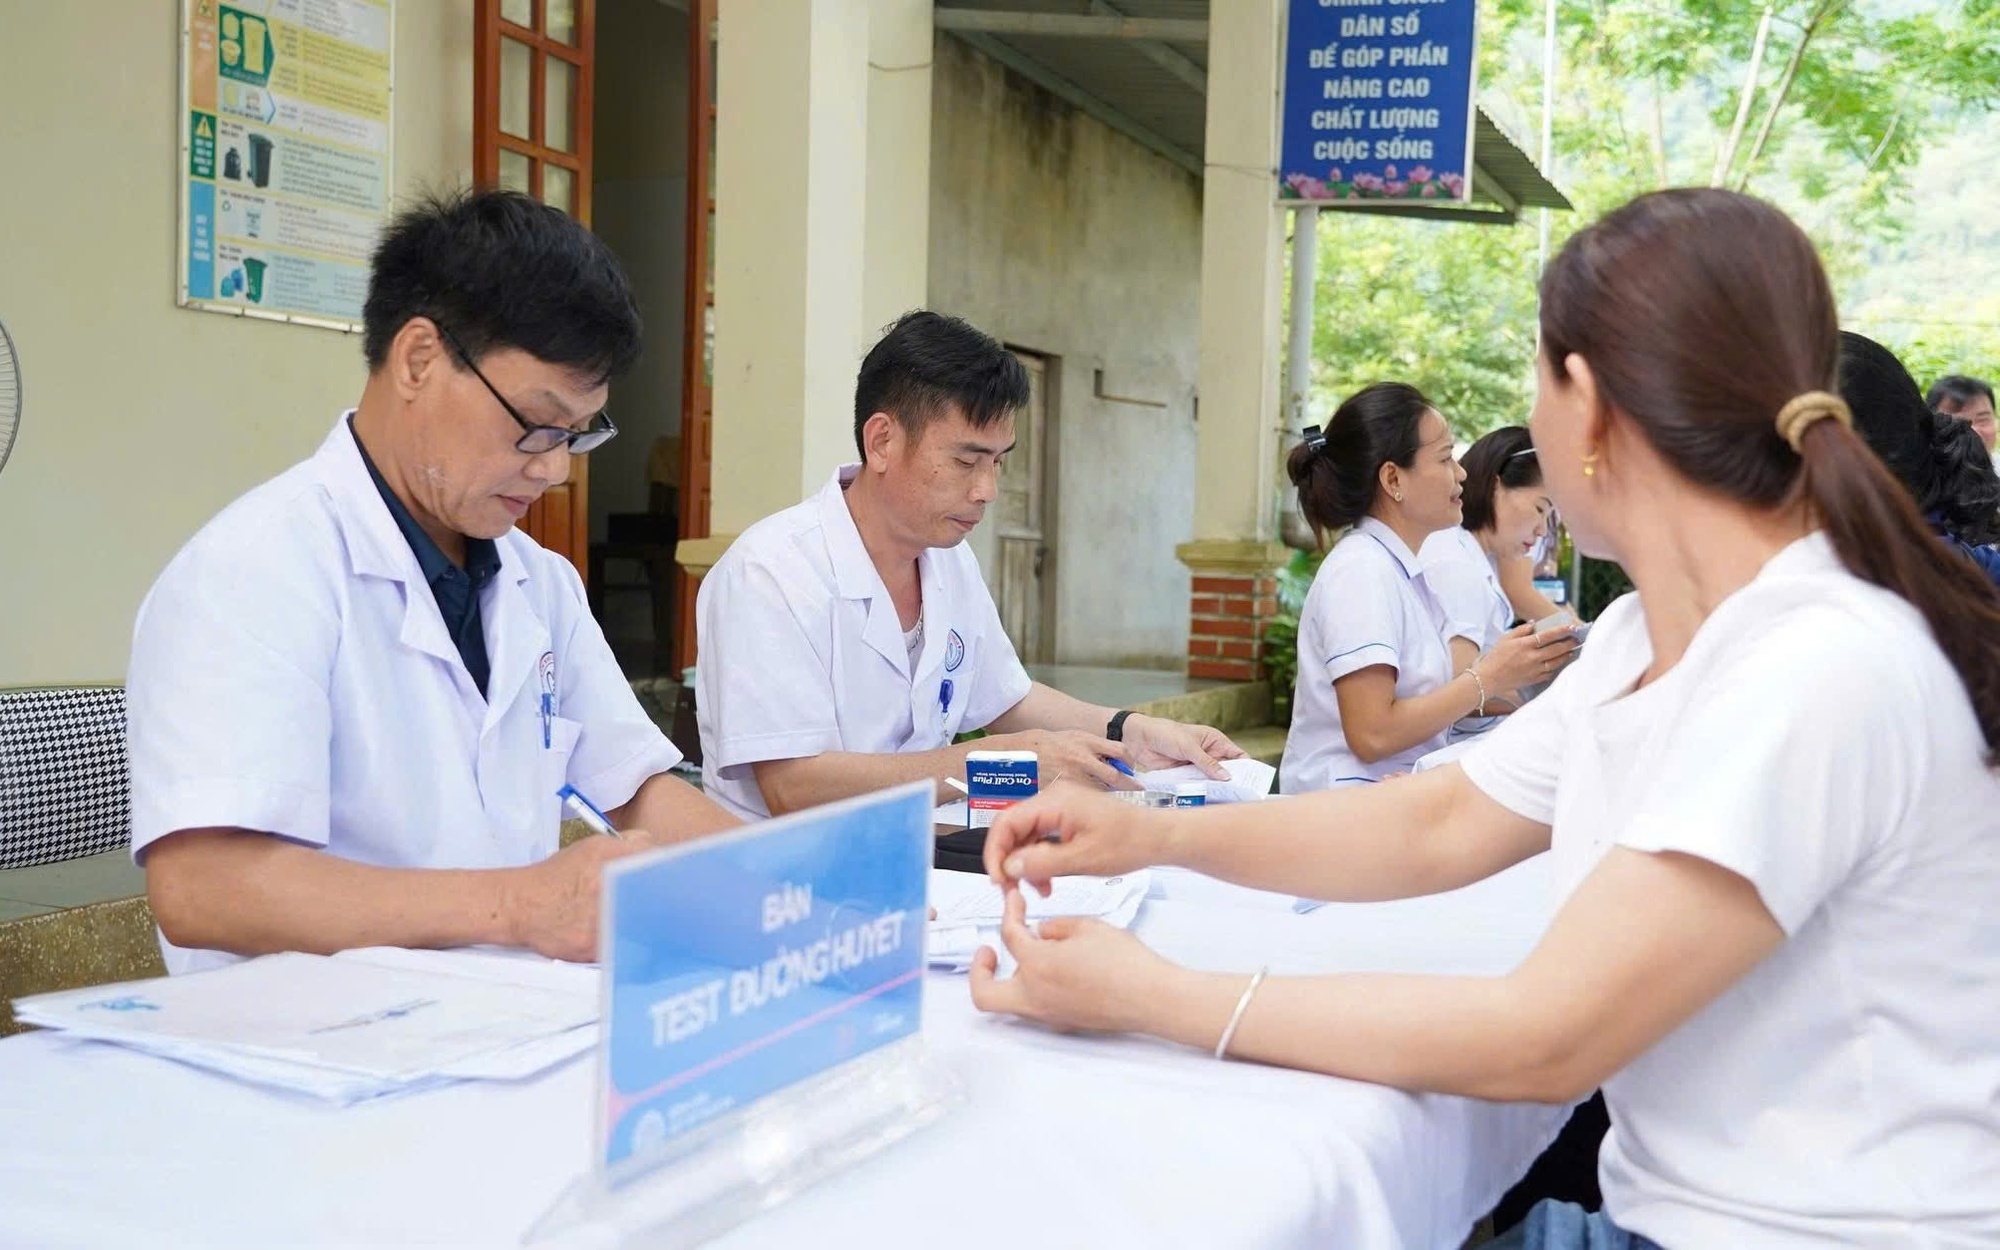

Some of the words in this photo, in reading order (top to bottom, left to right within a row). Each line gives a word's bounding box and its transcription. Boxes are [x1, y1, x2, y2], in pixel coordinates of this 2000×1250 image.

[1341, 14, 1385, 37] DÂN
[1390, 9, 1421, 36] SỐ
[1341, 46, 1384, 68] GÓP
[1323, 76, 1383, 99] NÂNG
[1388, 78, 1430, 98] CAO
[1311, 104, 1365, 130] CHẤT
[1369, 106, 1440, 132] LƯỢNG
[1313, 137, 1369, 164] CUỘC
[1374, 133, 1434, 160] SỐNG
[995, 777, 1015, 785] Call
[762, 881, 813, 933] BÀN
[651, 979, 725, 1046] TEST
[729, 942, 830, 1015] ĐƯỜNG
[831, 909, 907, 972] HUYẾT
